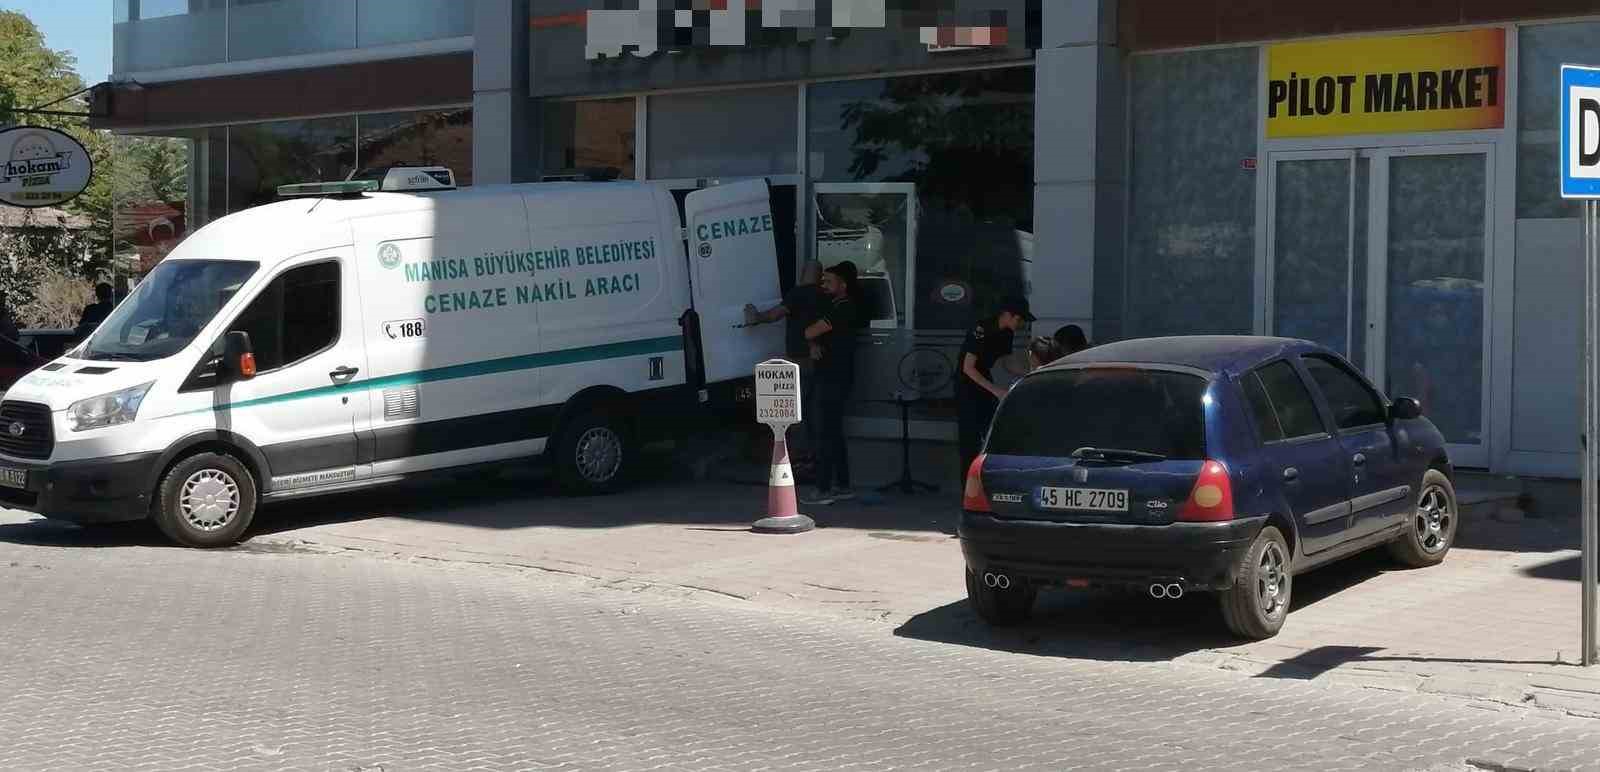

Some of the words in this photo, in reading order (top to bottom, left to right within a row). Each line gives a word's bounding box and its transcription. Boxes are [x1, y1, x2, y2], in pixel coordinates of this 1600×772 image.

[1268, 72, 1356, 118] PİLOT
[1364, 66, 1499, 113] MARKET
[1579, 98, 1600, 167] D
[8, 159, 60, 176] hokam
[697, 214, 771, 241] CENAZE
[405, 256, 469, 282] MANİSA
[474, 245, 570, 277] BÜYÜKŞEHİR
[576, 236, 656, 266] BELEDİYESİ
[424, 287, 507, 314] CENAZE
[516, 279, 576, 304] NAKİL
[585, 273, 640, 297] ARACI
[400, 322, 422, 338] 188
[758, 370, 794, 380] HOKAM
[773, 383, 795, 392] pizza
[1042, 489, 1057, 506] 45
[1065, 491, 1082, 507] HC
[1088, 492, 1126, 510] 2709
[1146, 499, 1168, 509] Clio
